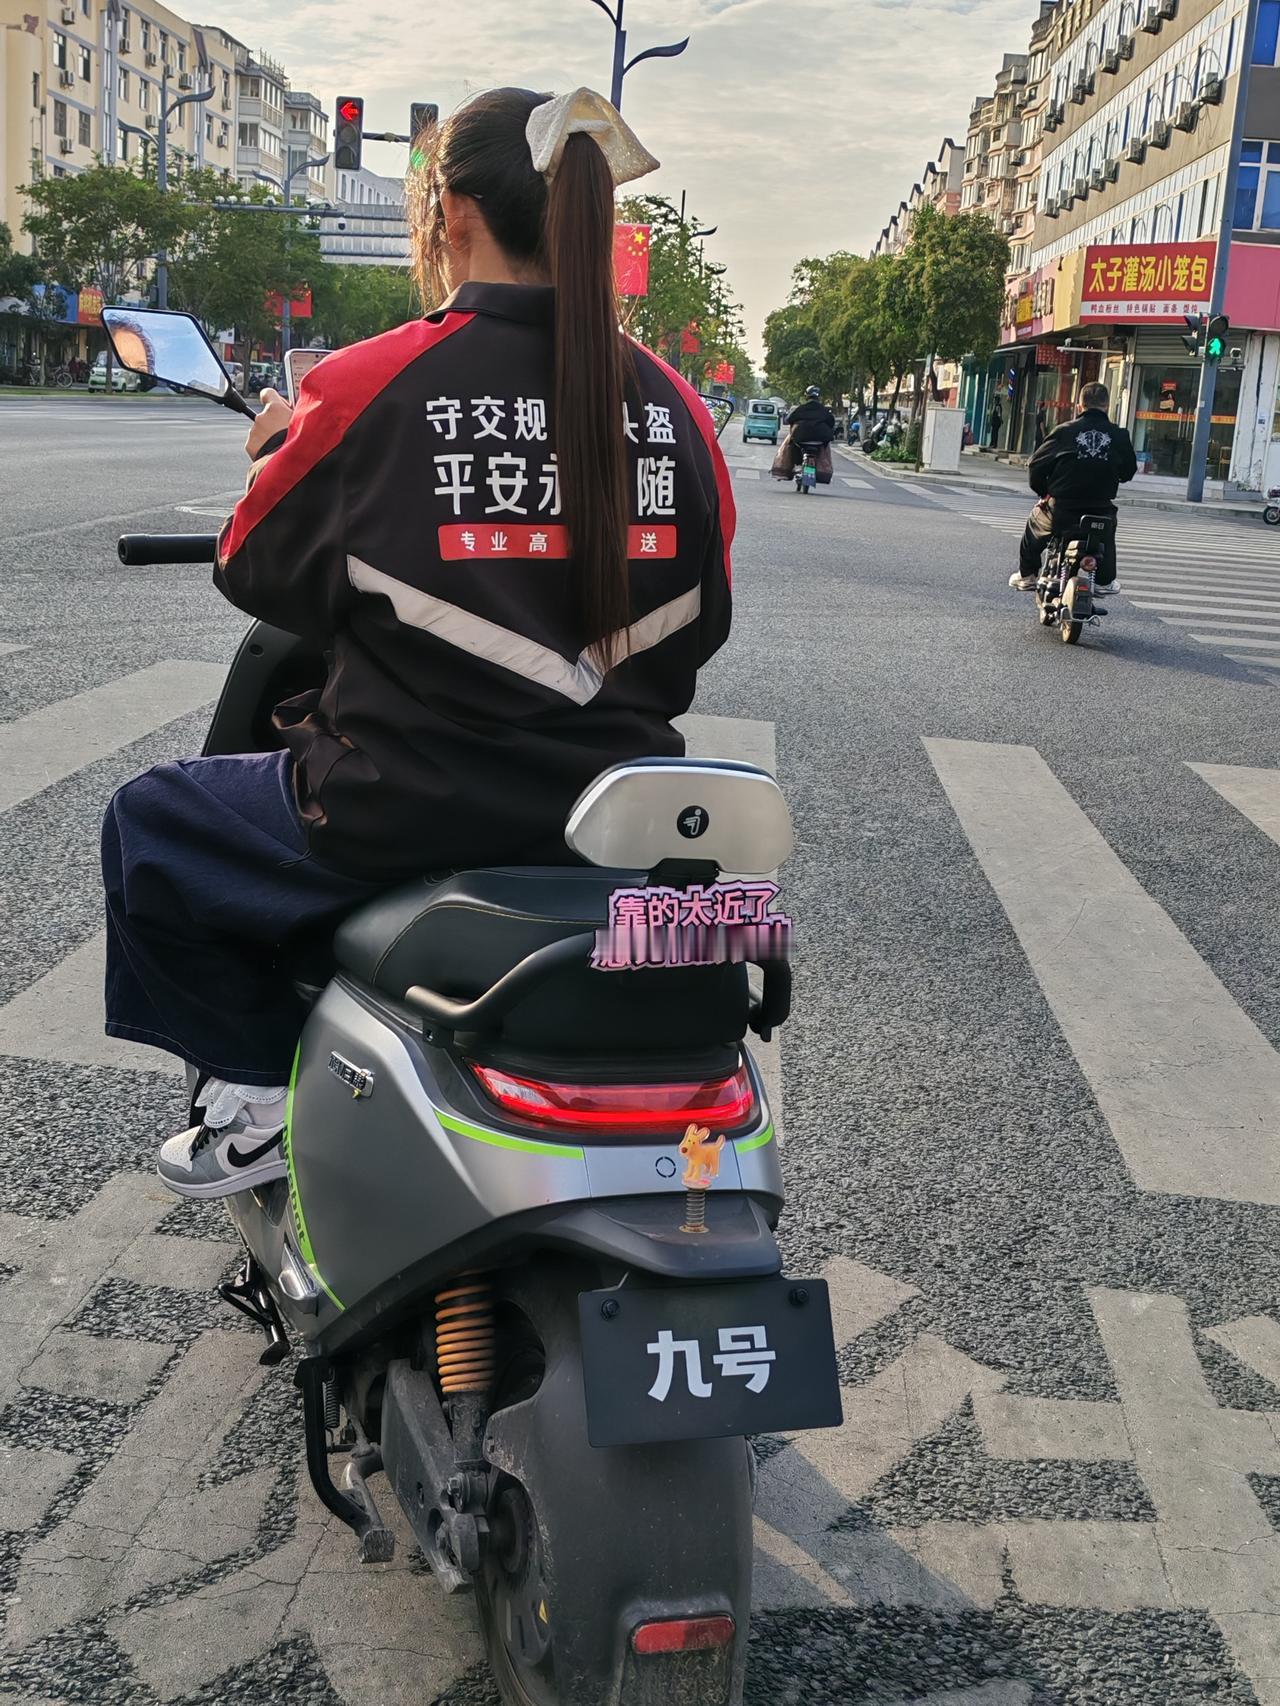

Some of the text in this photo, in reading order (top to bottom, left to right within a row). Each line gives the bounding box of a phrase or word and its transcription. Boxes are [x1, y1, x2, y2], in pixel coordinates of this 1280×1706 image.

[1088, 254, 1208, 292] 太子灌汤小笼包
[616, 890, 773, 926] 靠的太近了
[647, 1325, 776, 1402] 九号
